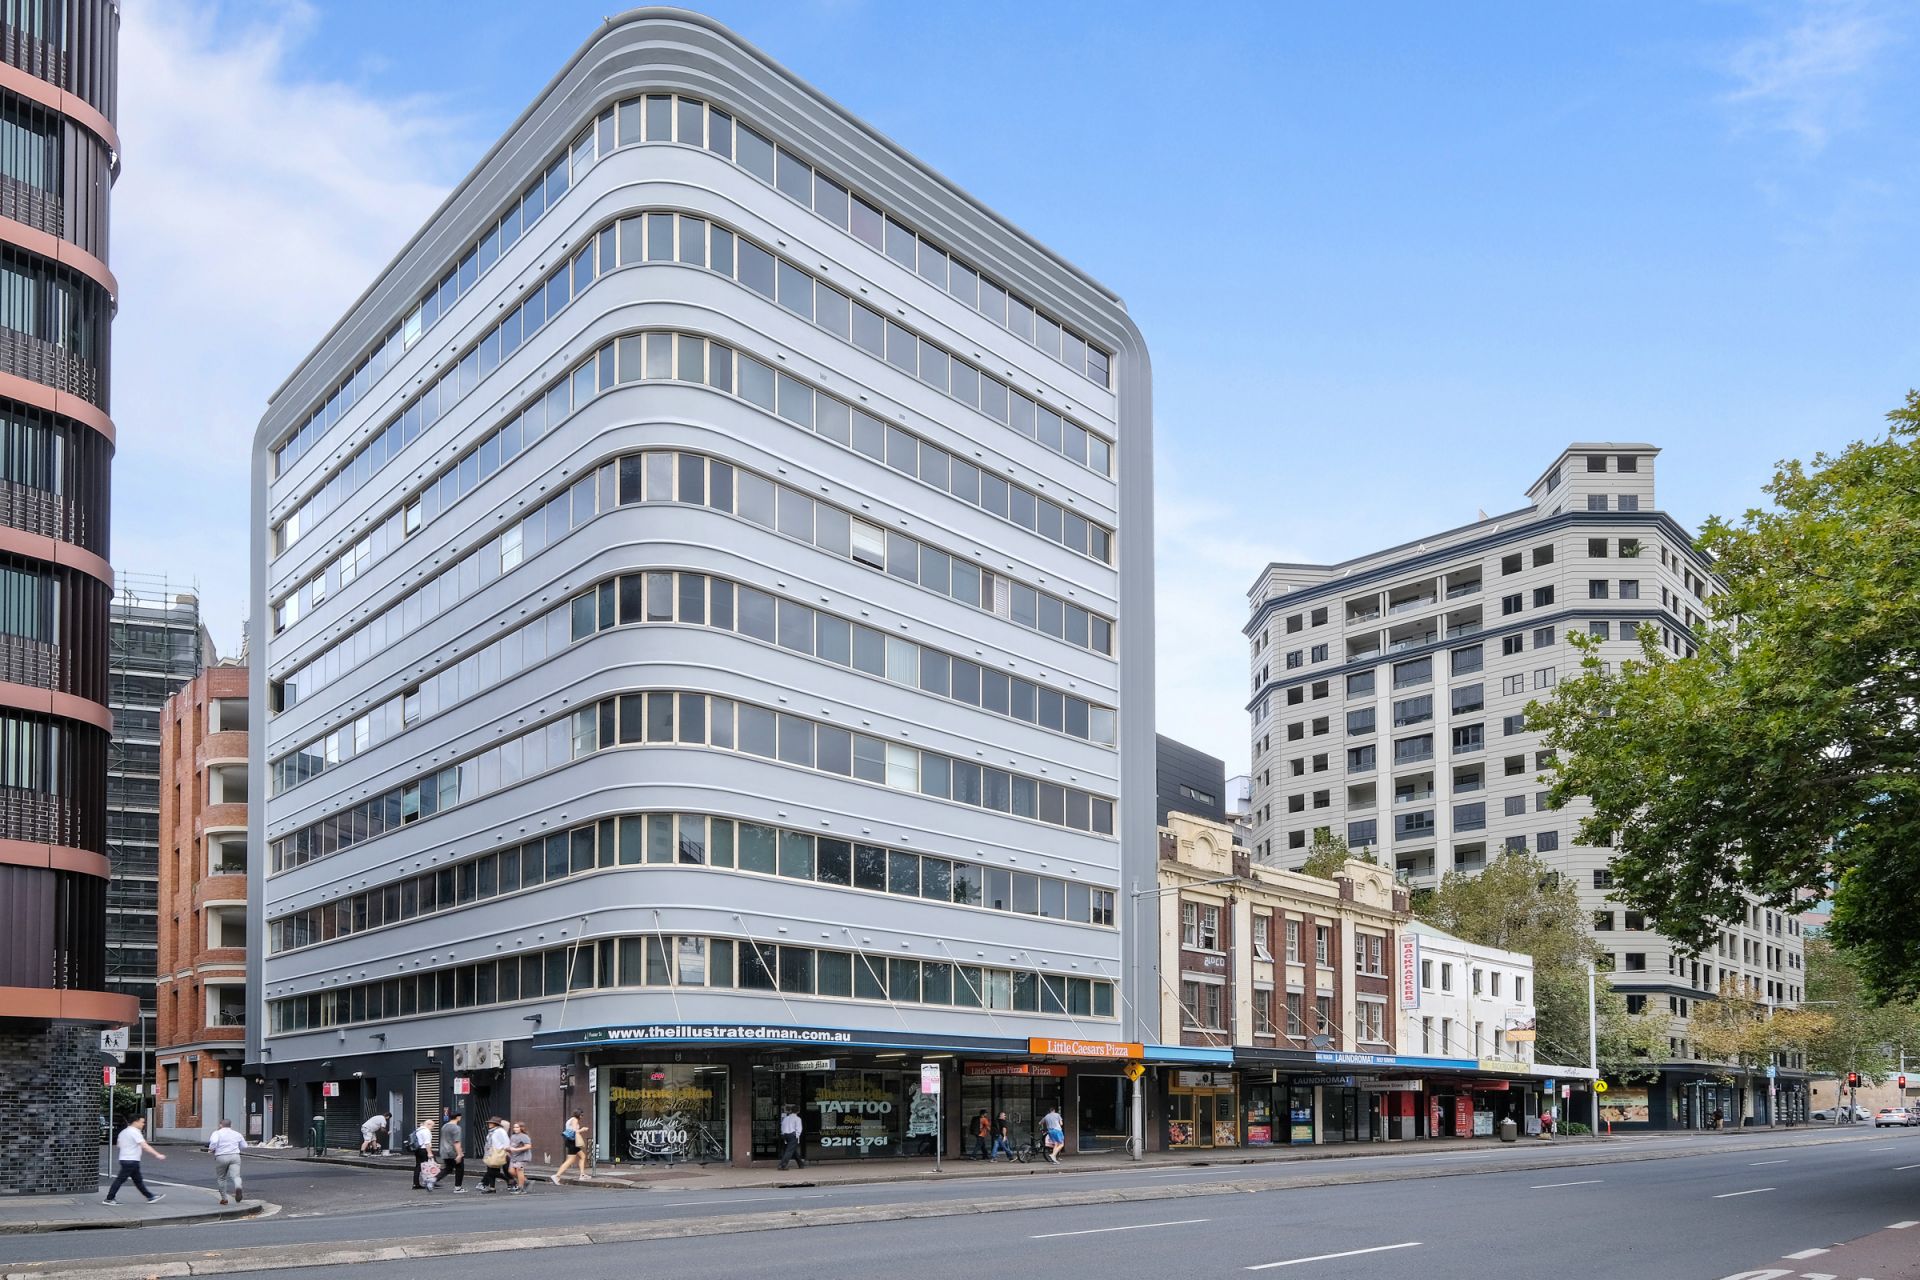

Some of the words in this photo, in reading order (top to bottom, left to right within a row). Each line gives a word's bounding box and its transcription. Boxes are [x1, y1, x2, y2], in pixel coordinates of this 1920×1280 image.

[1404, 943, 1414, 1001] BACKPACKERS
[607, 1026, 851, 1041] www.theillustratedman.com.au
[1047, 1040, 1071, 1053] Little
[1071, 1042, 1105, 1055] Caesars
[1106, 1043, 1128, 1056] Pizza
[1335, 1054, 1374, 1064] LAUNDROMAT
[1007, 1066, 1023, 1074] Pizza
[1032, 1065, 1051, 1076] Pizza
[650, 1072, 665, 1080] OPEN
[1293, 1076, 1350, 1085] LAUNDROMAT
[816, 1100, 892, 1114] TATTOO
[637, 1119, 664, 1129] Walk
[668, 1119, 683, 1129] in
[632, 1130, 687, 1145] TATTOO
